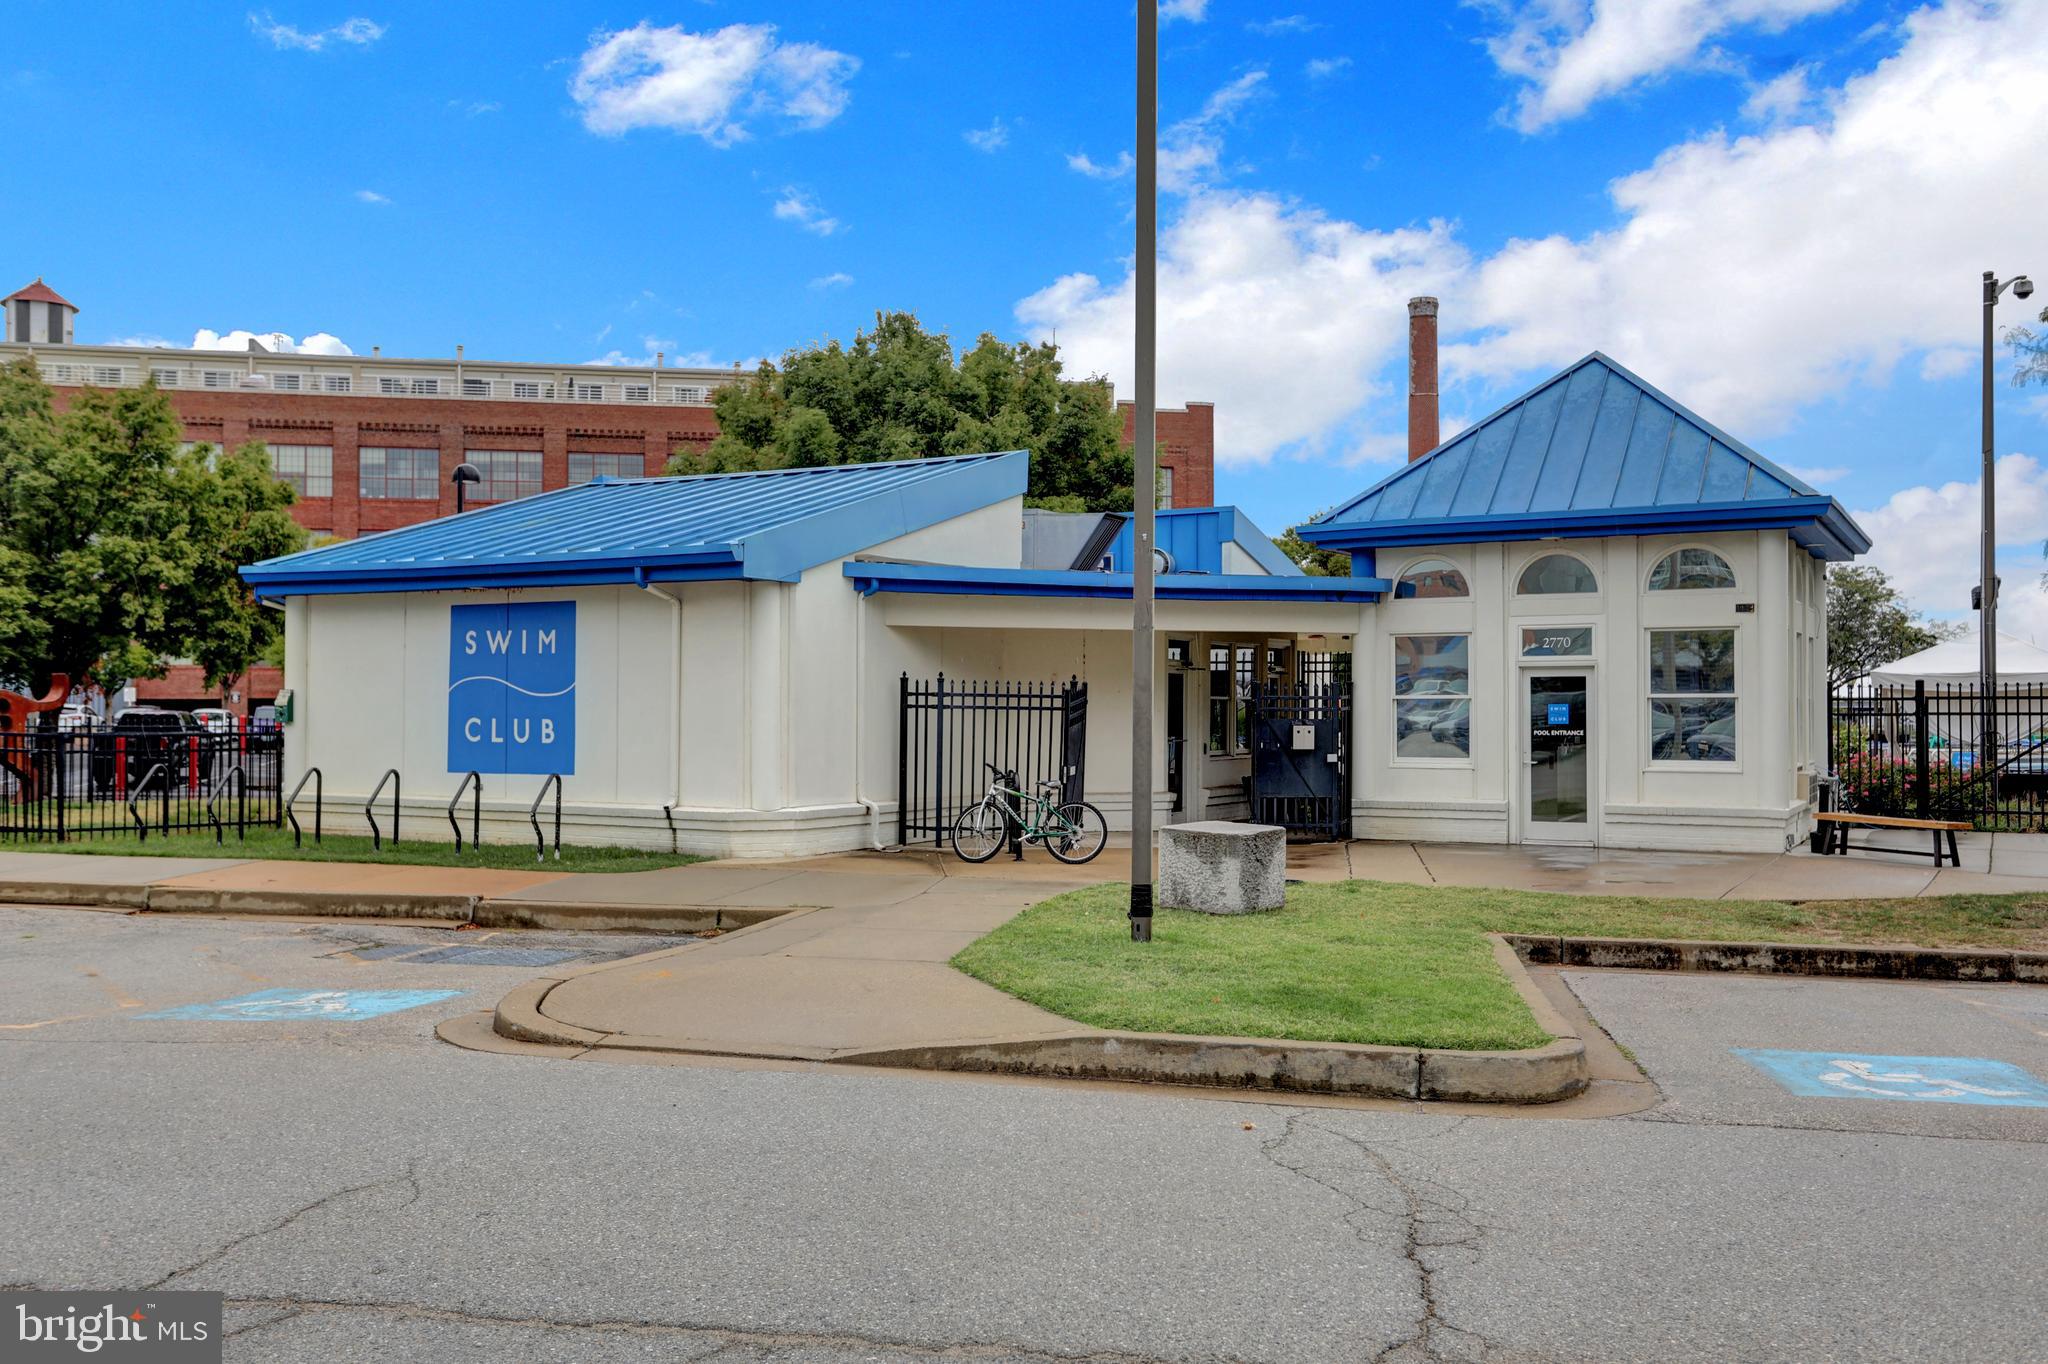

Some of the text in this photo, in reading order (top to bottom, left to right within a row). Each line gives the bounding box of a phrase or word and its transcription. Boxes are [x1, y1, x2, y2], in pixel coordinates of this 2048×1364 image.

[465, 629, 556, 655] SWIM
[1542, 637, 1571, 648] 2770
[464, 717, 555, 744] CLUB
